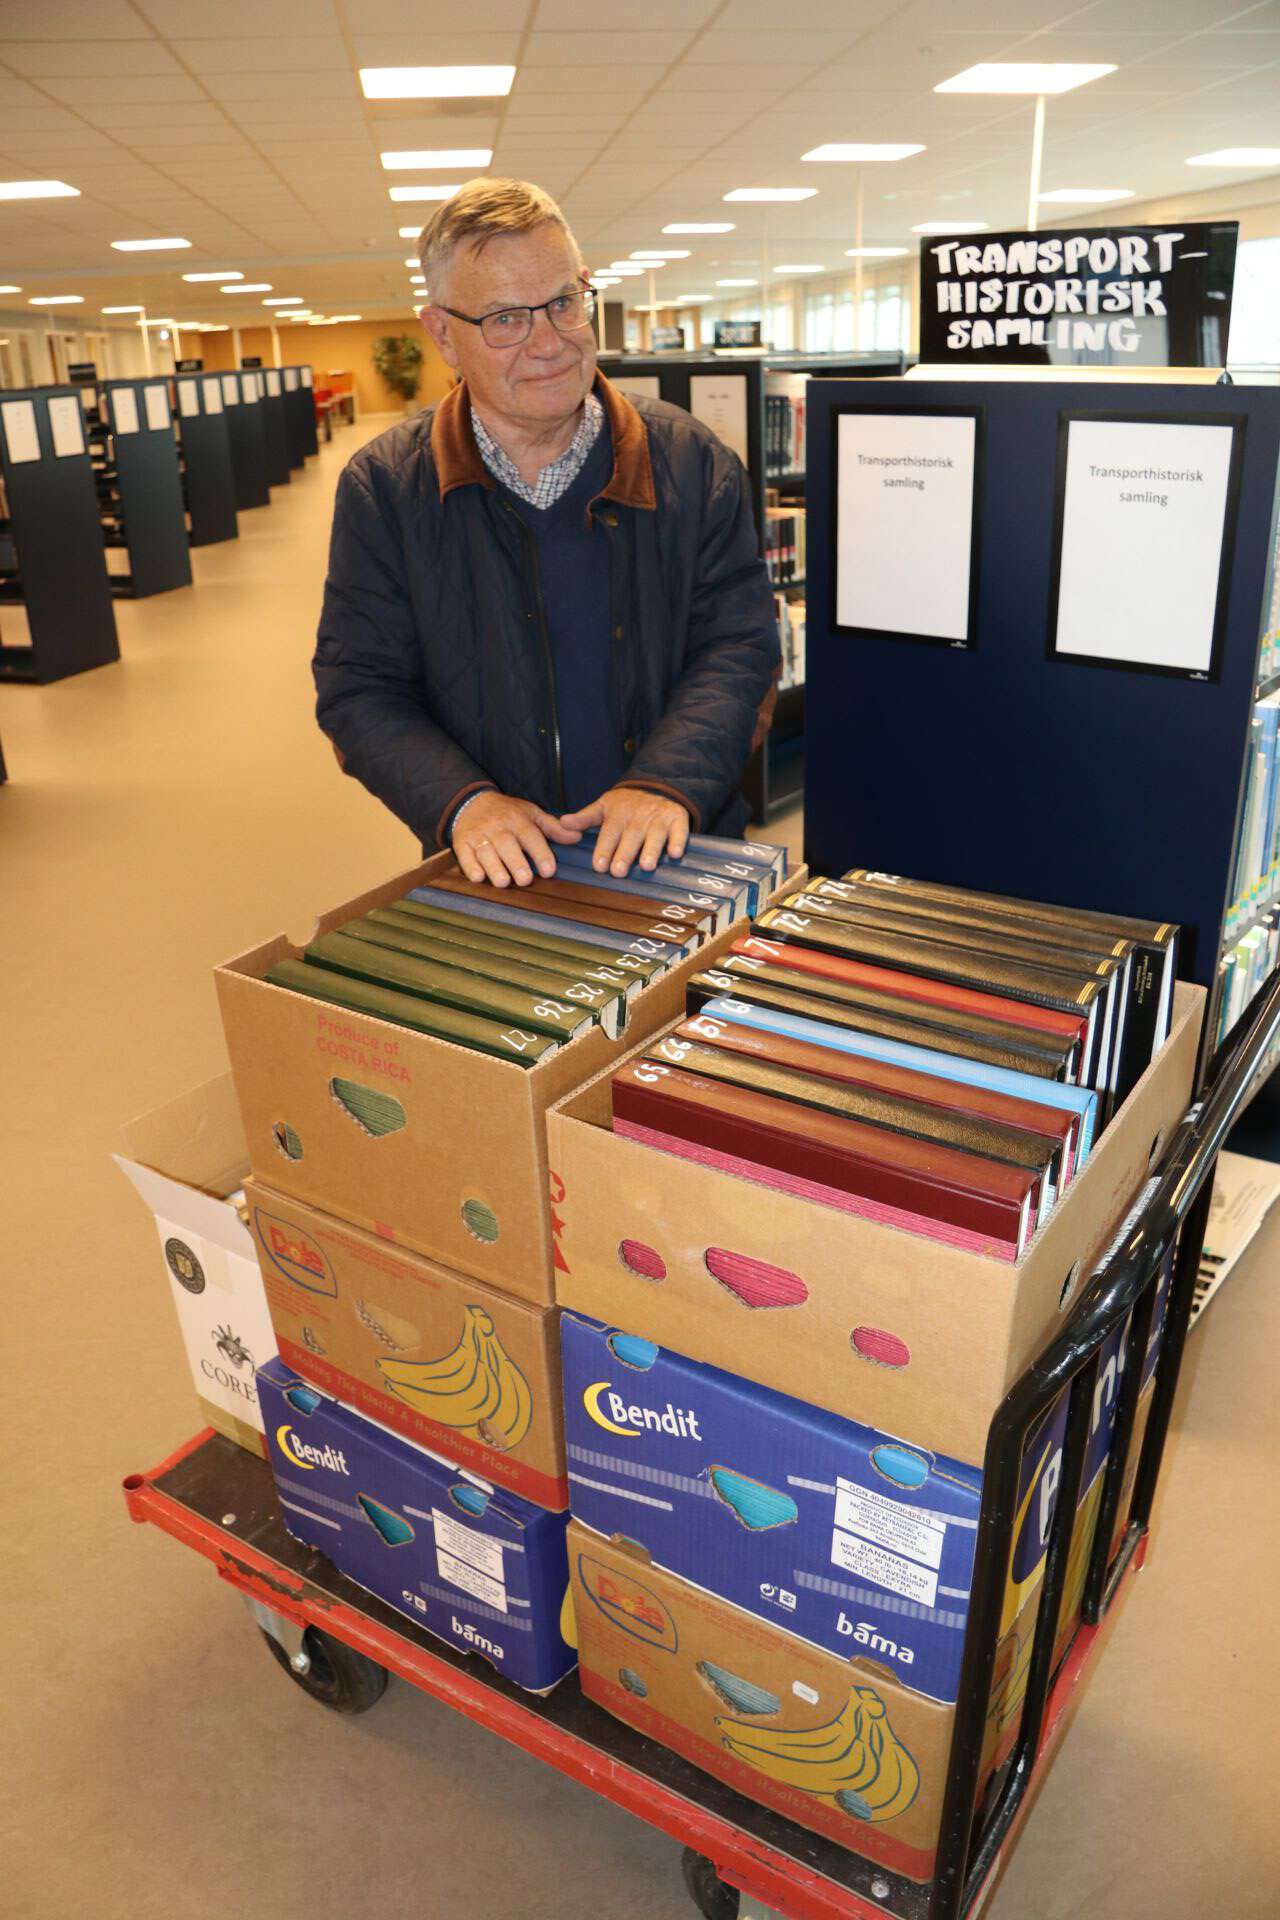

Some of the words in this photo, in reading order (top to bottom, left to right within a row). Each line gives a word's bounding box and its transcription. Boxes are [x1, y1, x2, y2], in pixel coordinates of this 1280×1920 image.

[936, 278, 1167, 317] HISTORISK
[947, 318, 1142, 352] SAMLING
[857, 454, 953, 470] Transporthistorisk
[883, 476, 925, 490] samling
[1089, 465, 1204, 483] Transporthistorisk
[1119, 491, 1168, 507] samling
[742, 842, 773, 857] 16
[724, 862, 753, 877] 17
[698, 876, 733, 890] 18
[689, 893, 718, 906] 19
[794, 893, 832, 912] 73
[662, 904, 695, 920] 20
[649, 923, 686, 938] 21
[770, 912, 811, 932] 72
[630, 937, 666, 956] 22
[744, 936, 785, 956] 71
[616, 953, 650, 970] 23
[585, 966, 624, 983] 24
[565, 983, 604, 1002] 25
[534, 1000, 575, 1020] 26
[317, 1013, 379, 1049] Produce
[384, 1041, 400, 1055] of
[688, 1016, 728, 1038] 67
[501, 1029, 537, 1051] 27
[661, 1037, 693, 1060] 66
[317, 1036, 368, 1066] COSTA
[371, 1056, 412, 1082] RICA
[633, 1063, 670, 1082] 65
[608, 1392, 702, 1441] Bendit
[290, 1433, 350, 1476] Bendit
[481, 1451, 520, 1479] Place
[859, 1543, 909, 1570] BANANAS
